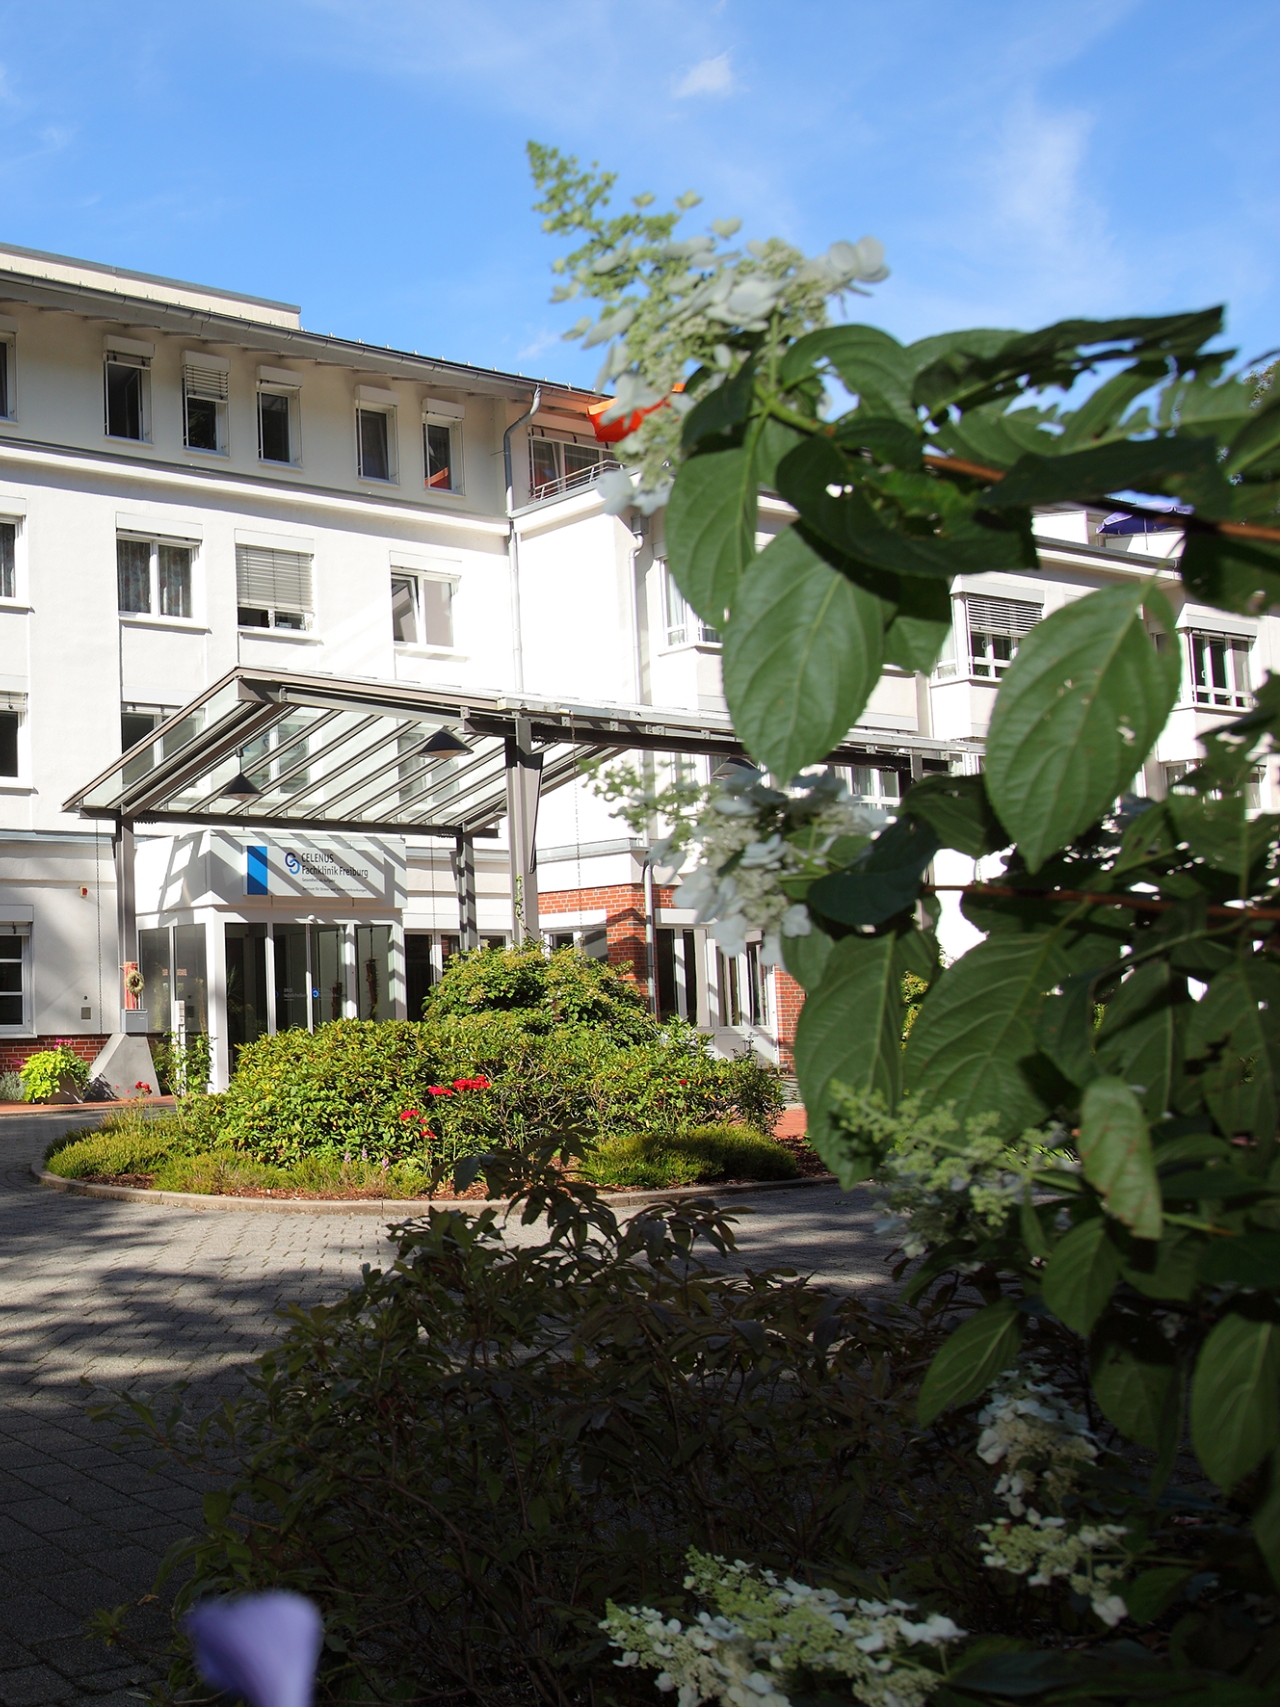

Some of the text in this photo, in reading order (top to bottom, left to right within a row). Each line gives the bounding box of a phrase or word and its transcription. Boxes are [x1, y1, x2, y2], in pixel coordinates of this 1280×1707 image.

[301, 853, 334, 863] CELENUS
[302, 865, 369, 879] Fachklinik Freiburg
